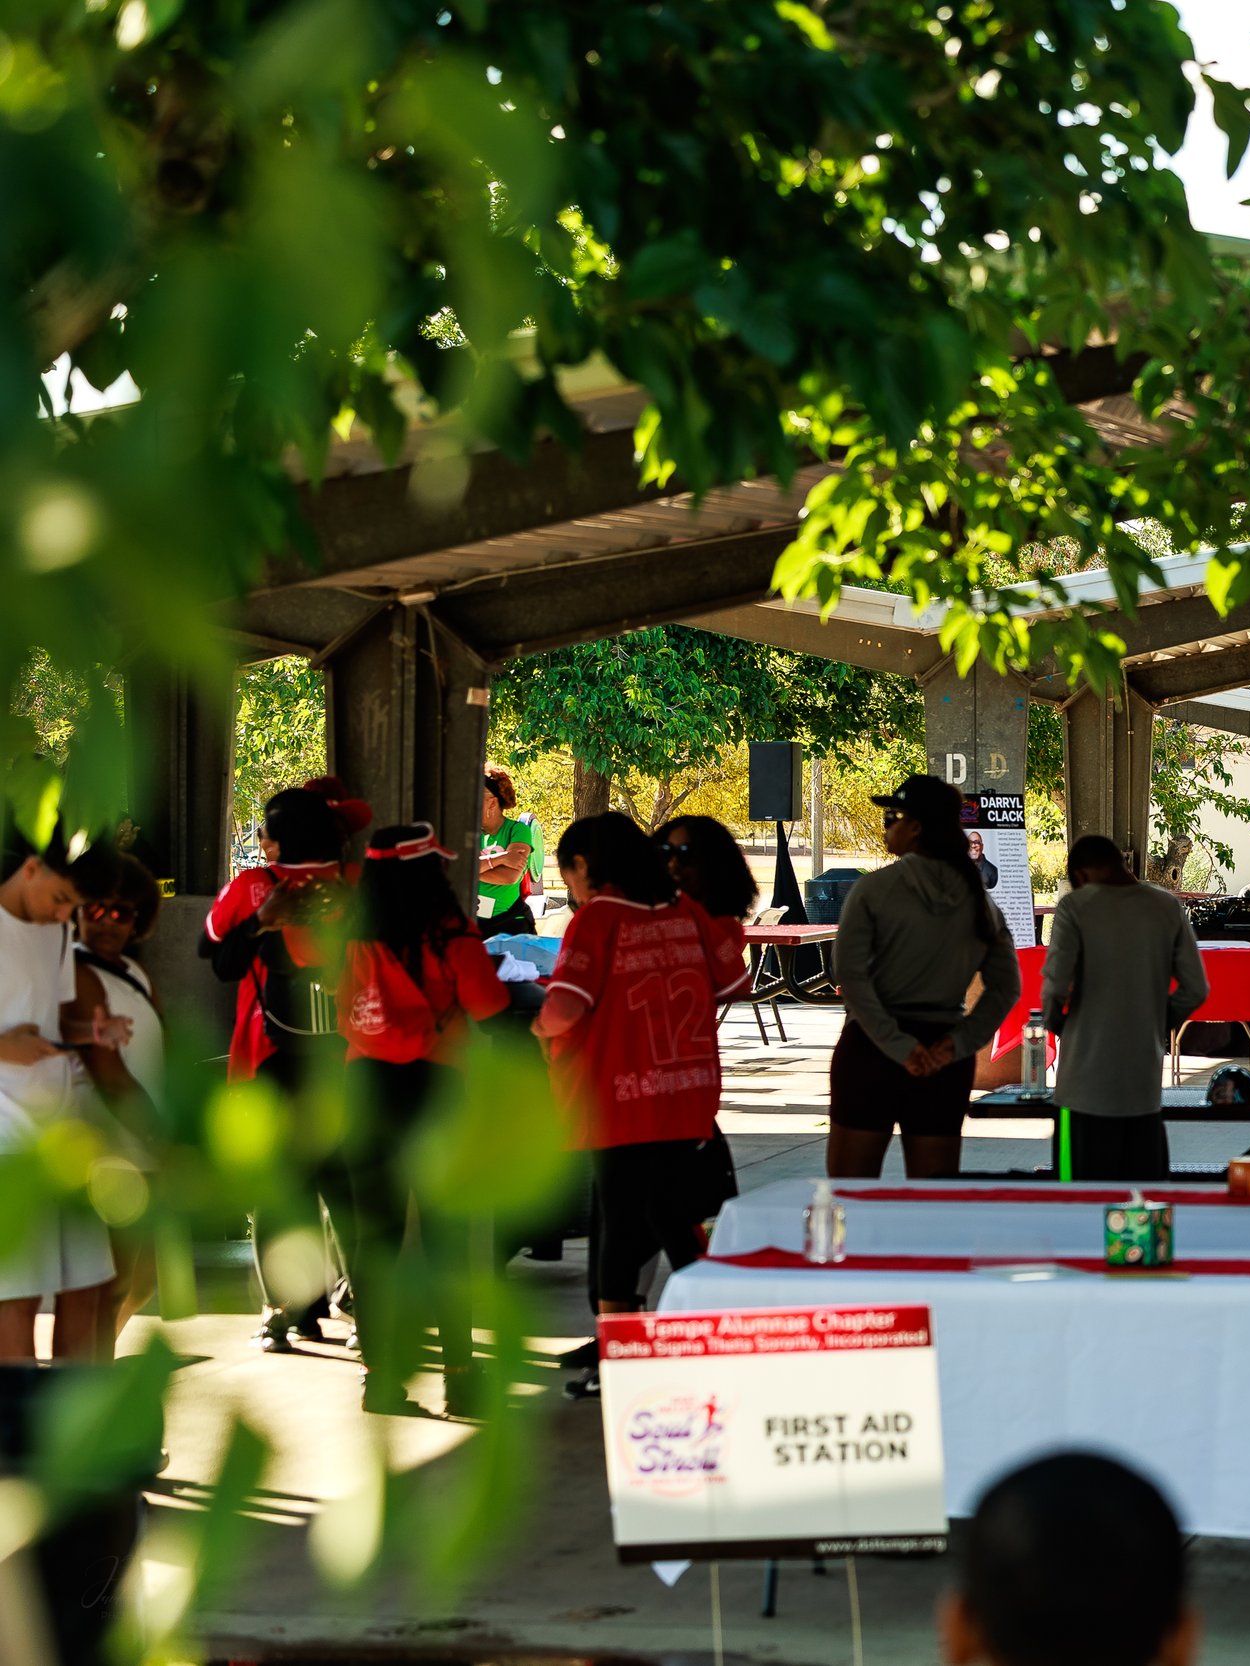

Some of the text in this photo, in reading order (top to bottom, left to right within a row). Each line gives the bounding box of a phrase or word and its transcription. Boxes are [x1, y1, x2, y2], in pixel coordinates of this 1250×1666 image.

[945, 753, 967, 784] D
[980, 796, 1023, 809] DARRYL
[987, 810, 1024, 823] CLACK
[626, 967, 714, 1066] 12
[812, 1308, 898, 1334] Chapter
[764, 1411, 914, 1439] FIRST AID
[774, 1440, 908, 1466] STATION
